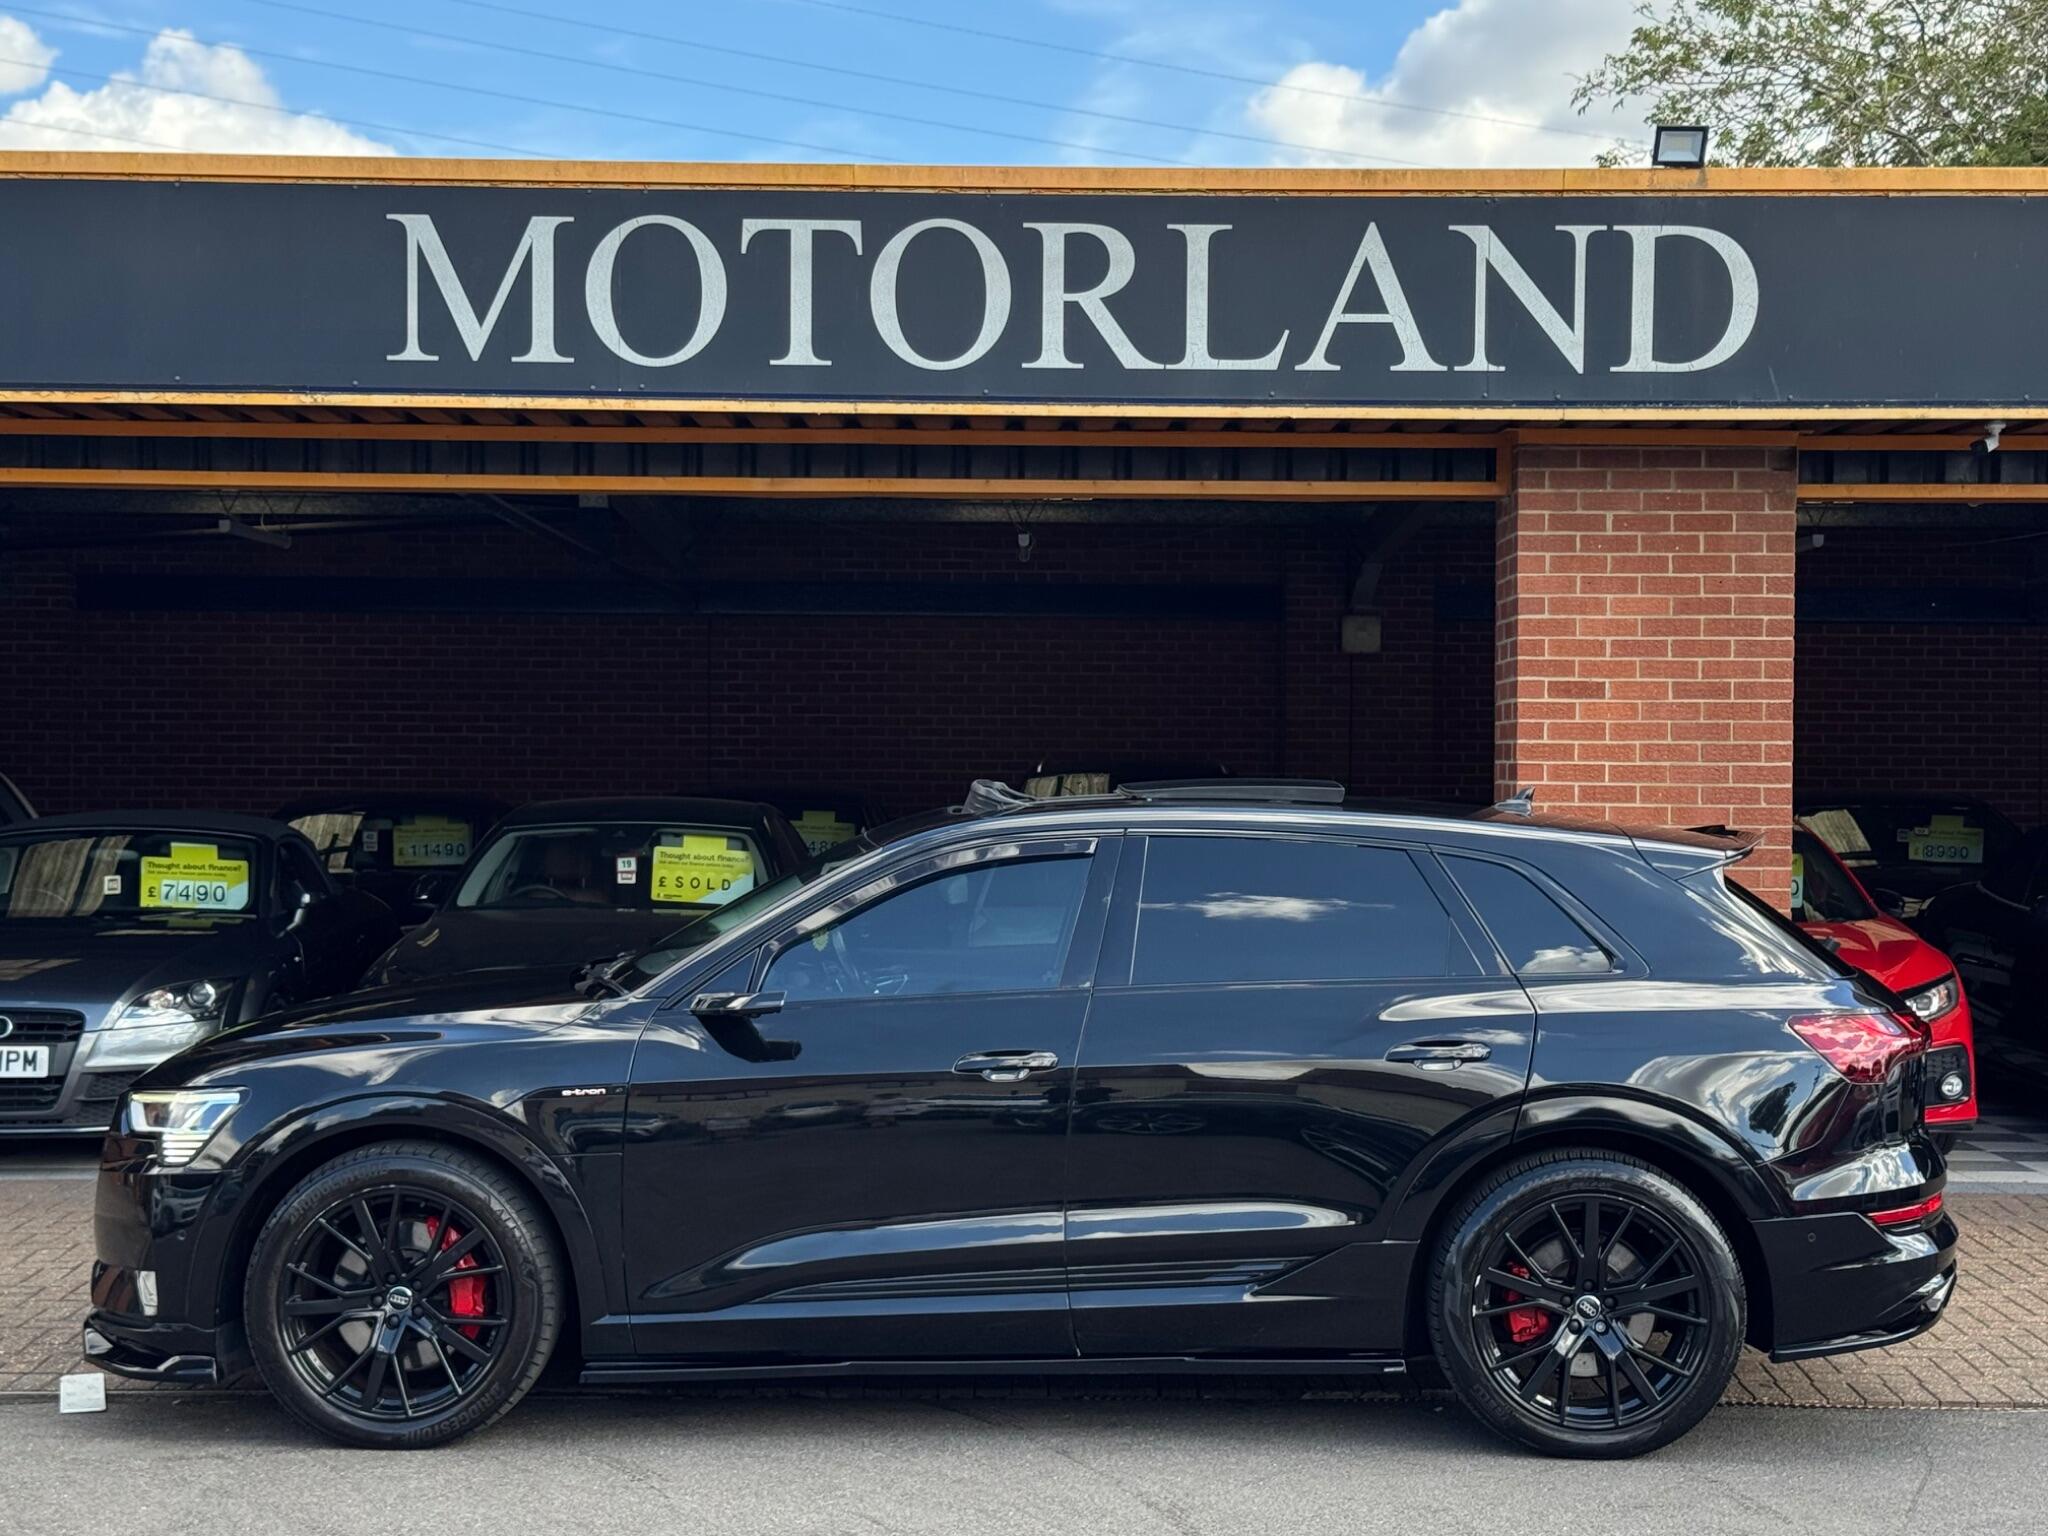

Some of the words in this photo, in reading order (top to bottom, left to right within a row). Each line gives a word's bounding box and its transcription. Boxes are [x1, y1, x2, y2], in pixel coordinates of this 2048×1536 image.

[386, 212, 1759, 374] MOTORLAND
[659, 851, 691, 861] Thought
[693, 853, 715, 861] about
[147, 860, 181, 870] Thought
[183, 862, 206, 871] about
[208, 863, 242, 872] finance?
[658, 876, 667, 887] £
[147, 886, 157, 898] £
[163, 883, 226, 903] 7490
[0, 1050, 38, 1072] PM
[561, 1087, 606, 1097] e-tron
